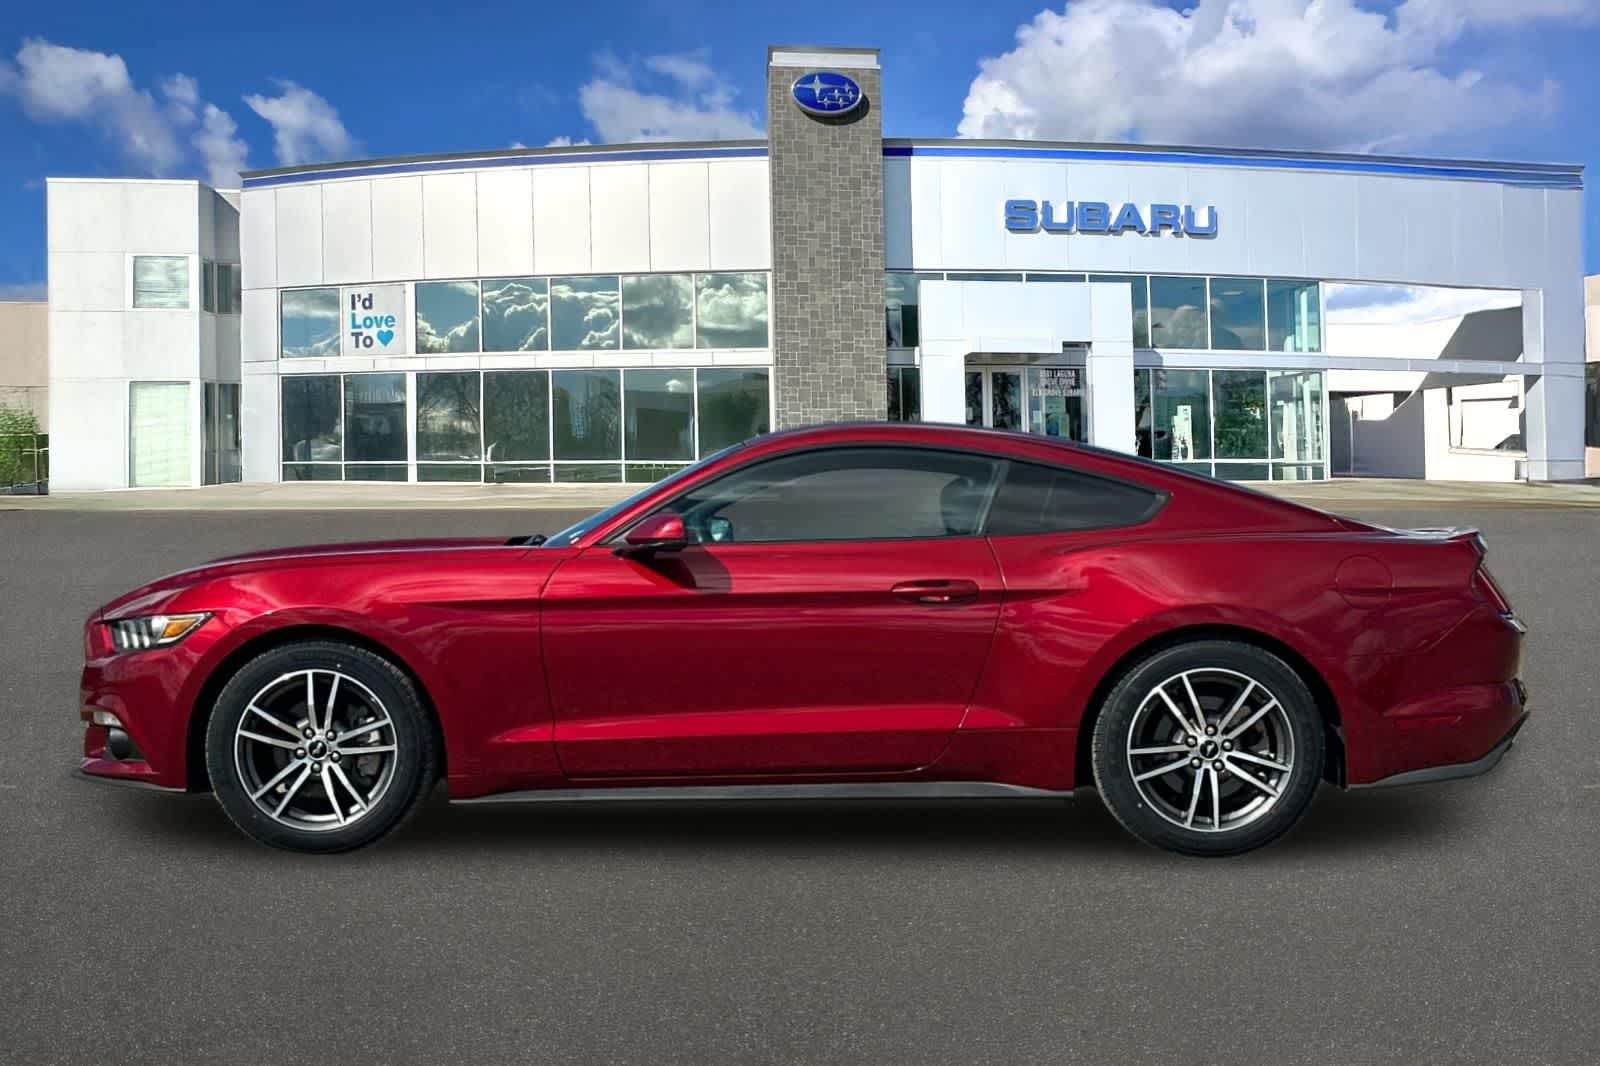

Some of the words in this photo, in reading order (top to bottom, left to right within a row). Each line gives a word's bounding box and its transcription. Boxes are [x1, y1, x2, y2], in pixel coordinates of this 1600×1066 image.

[1005, 199, 1217, 237] SUBARU
[351, 293, 373, 310] I'd
[351, 312, 396, 330] Love
[351, 331, 374, 348] To
